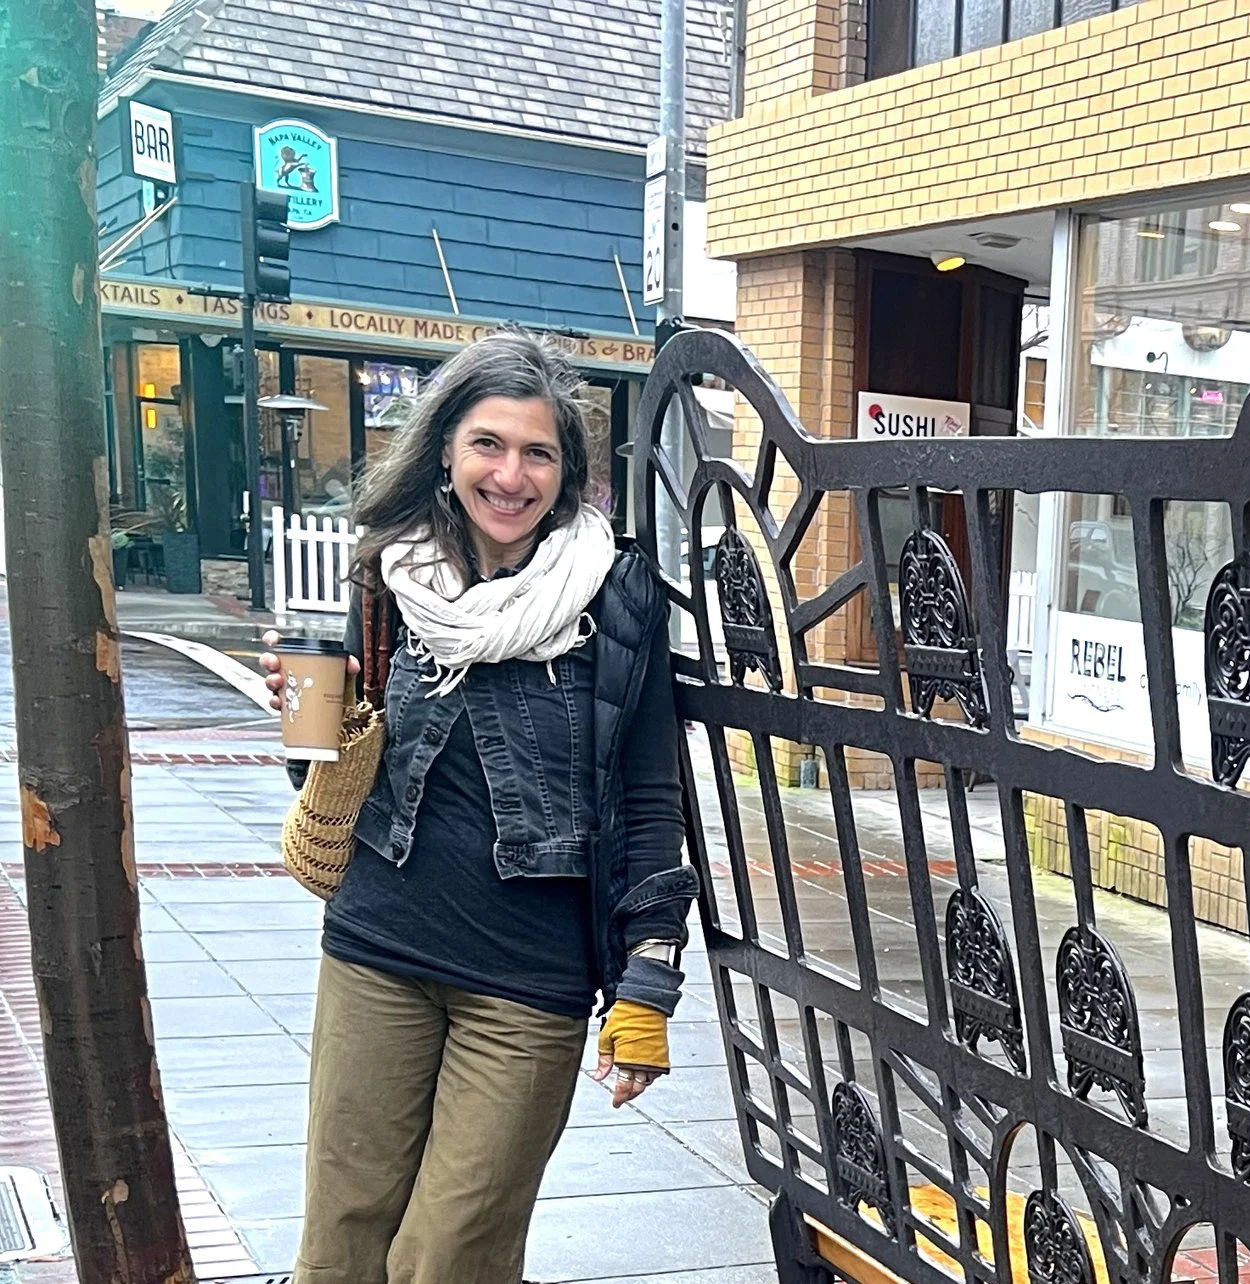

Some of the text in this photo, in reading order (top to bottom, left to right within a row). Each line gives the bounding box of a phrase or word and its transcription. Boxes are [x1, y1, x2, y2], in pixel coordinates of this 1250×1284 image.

[134, 119, 172, 164] BAR
[268, 131, 323, 151] NAPA VALLEY
[288, 195, 323, 207] TILLERY
[646, 247, 661, 292] 20
[99, 283, 161, 306] KTAILS
[202, 297, 290, 321] TASNGS
[329, 309, 405, 335] LOCALLY
[413, 320, 463, 341] MADE
[873, 411, 936, 437] SUSHI
[1070, 638, 1126, 682] REBEL
